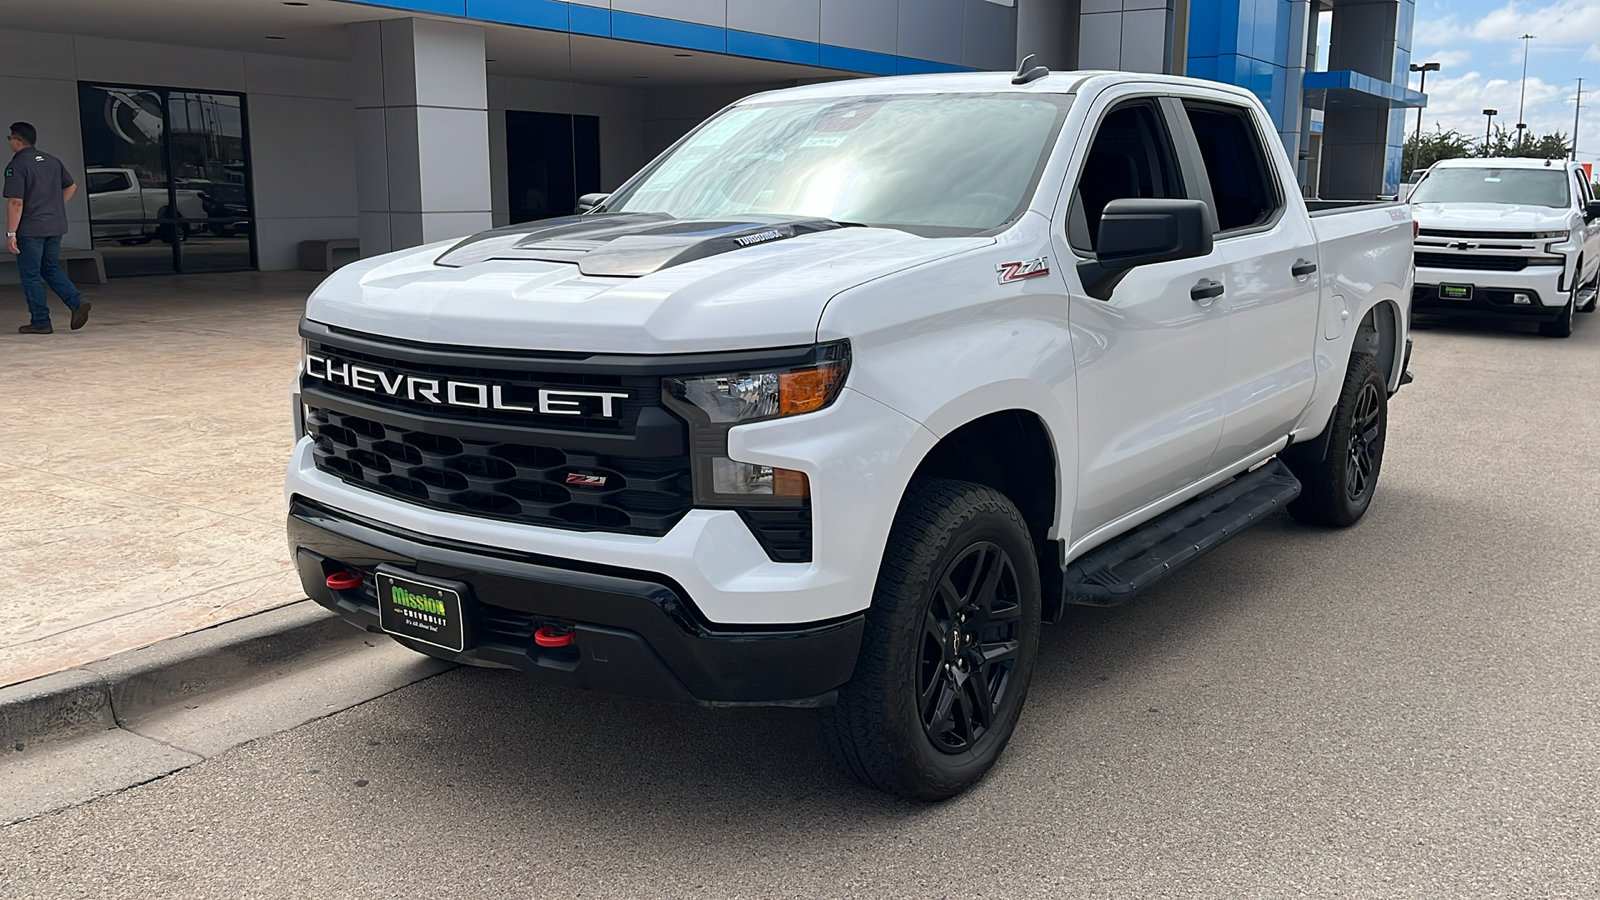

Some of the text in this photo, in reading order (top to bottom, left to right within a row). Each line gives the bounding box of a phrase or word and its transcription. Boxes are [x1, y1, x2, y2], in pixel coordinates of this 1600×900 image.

[994, 256, 1050, 285] Z71
[306, 354, 629, 417] CHEVROLET
[566, 472, 607, 486] Z71
[391, 585, 446, 616] Mission
[403, 608, 446, 626] CHEVROLET
